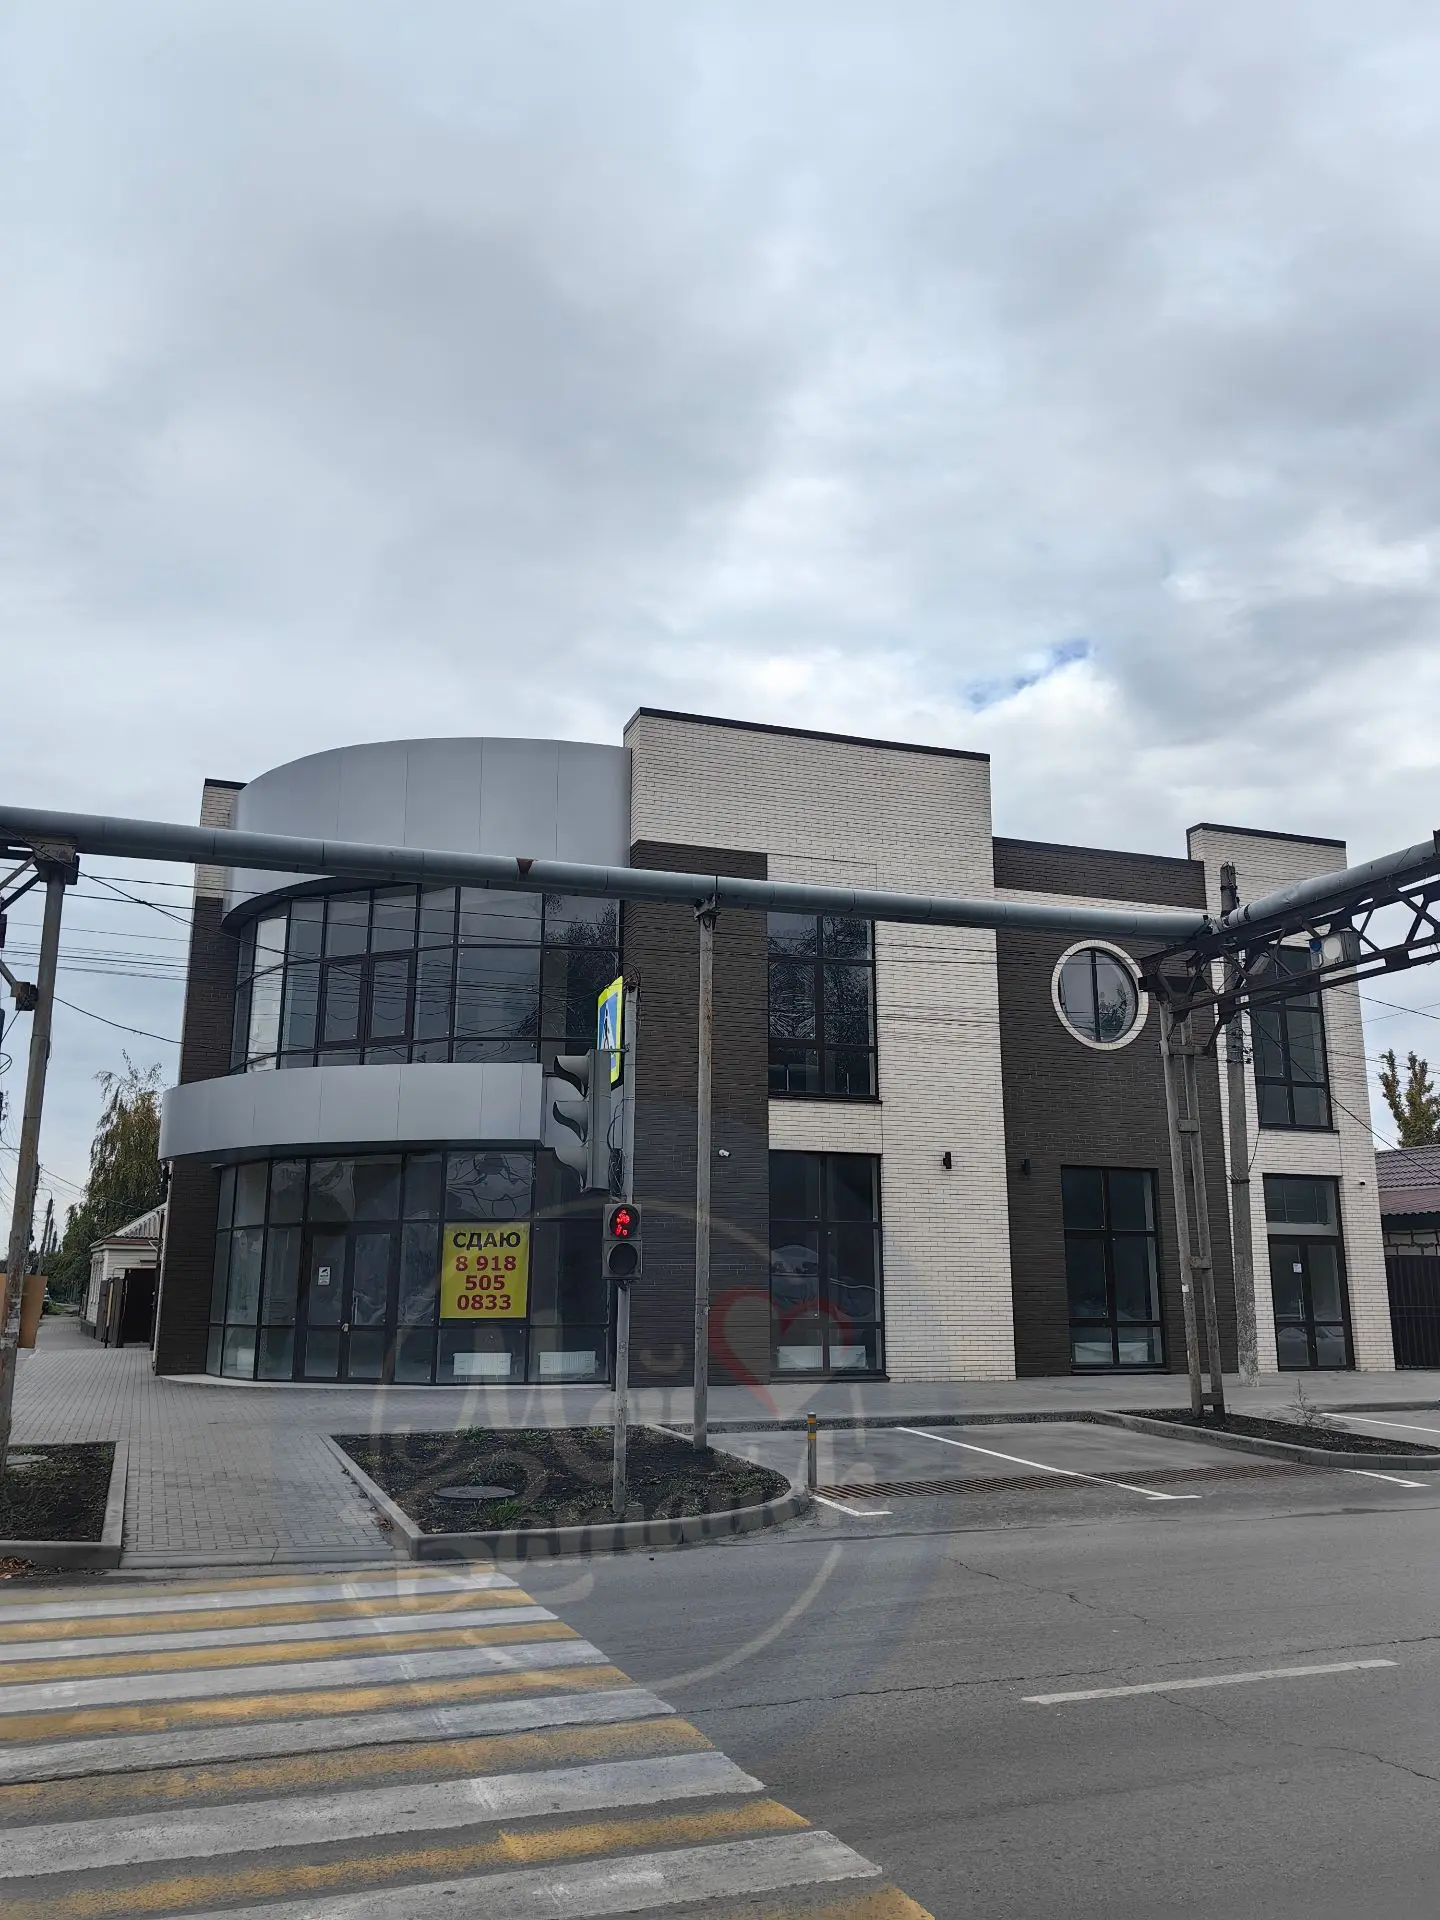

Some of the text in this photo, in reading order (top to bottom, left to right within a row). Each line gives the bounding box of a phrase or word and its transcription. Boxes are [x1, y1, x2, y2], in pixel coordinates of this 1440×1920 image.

[453, 1231, 520, 1250] СДАЮ
[455, 1255, 516, 1271] 8 918
[465, 1275, 506, 1291] 505
[457, 1294, 512, 1311] 0833
